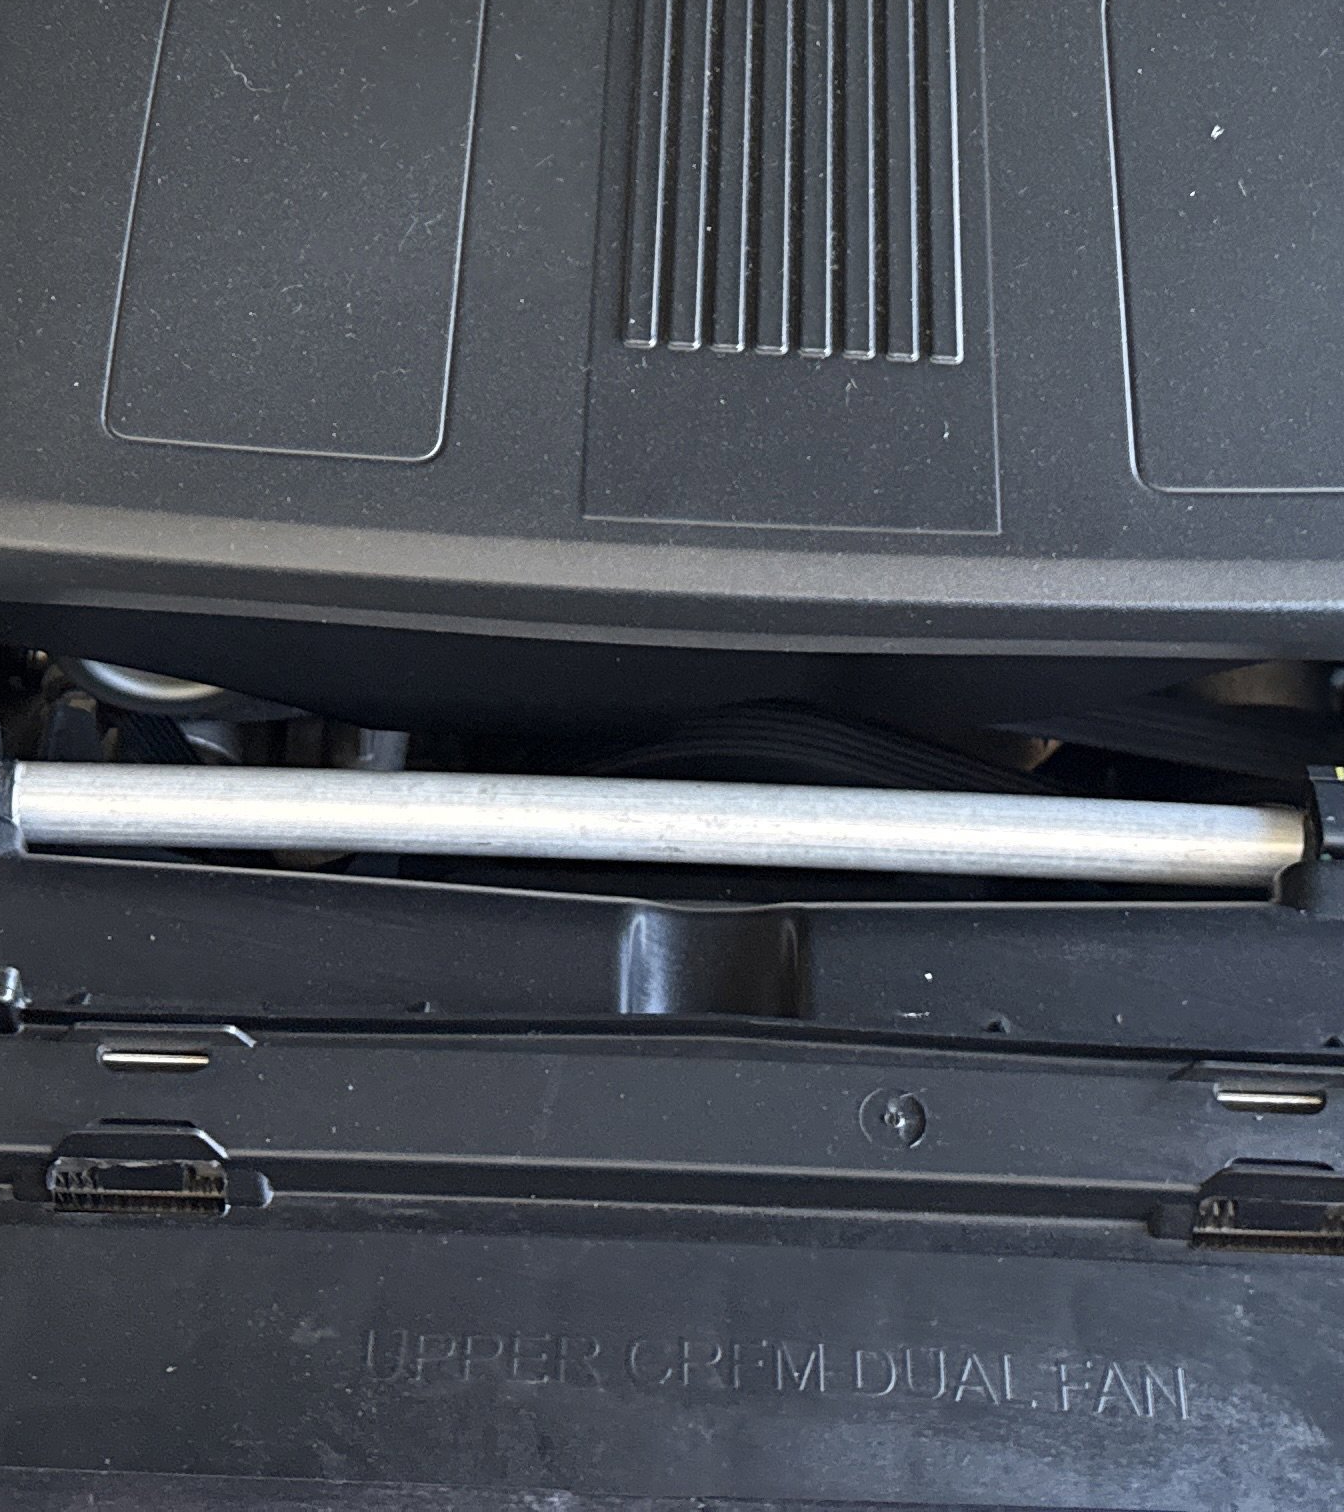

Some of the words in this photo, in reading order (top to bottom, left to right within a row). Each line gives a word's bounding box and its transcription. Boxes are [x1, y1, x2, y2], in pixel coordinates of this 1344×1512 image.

[365, 1328, 606, 1392] UPPER
[855, 1345, 1039, 1408] DUAL
[1058, 1358, 1190, 1421] FAN
